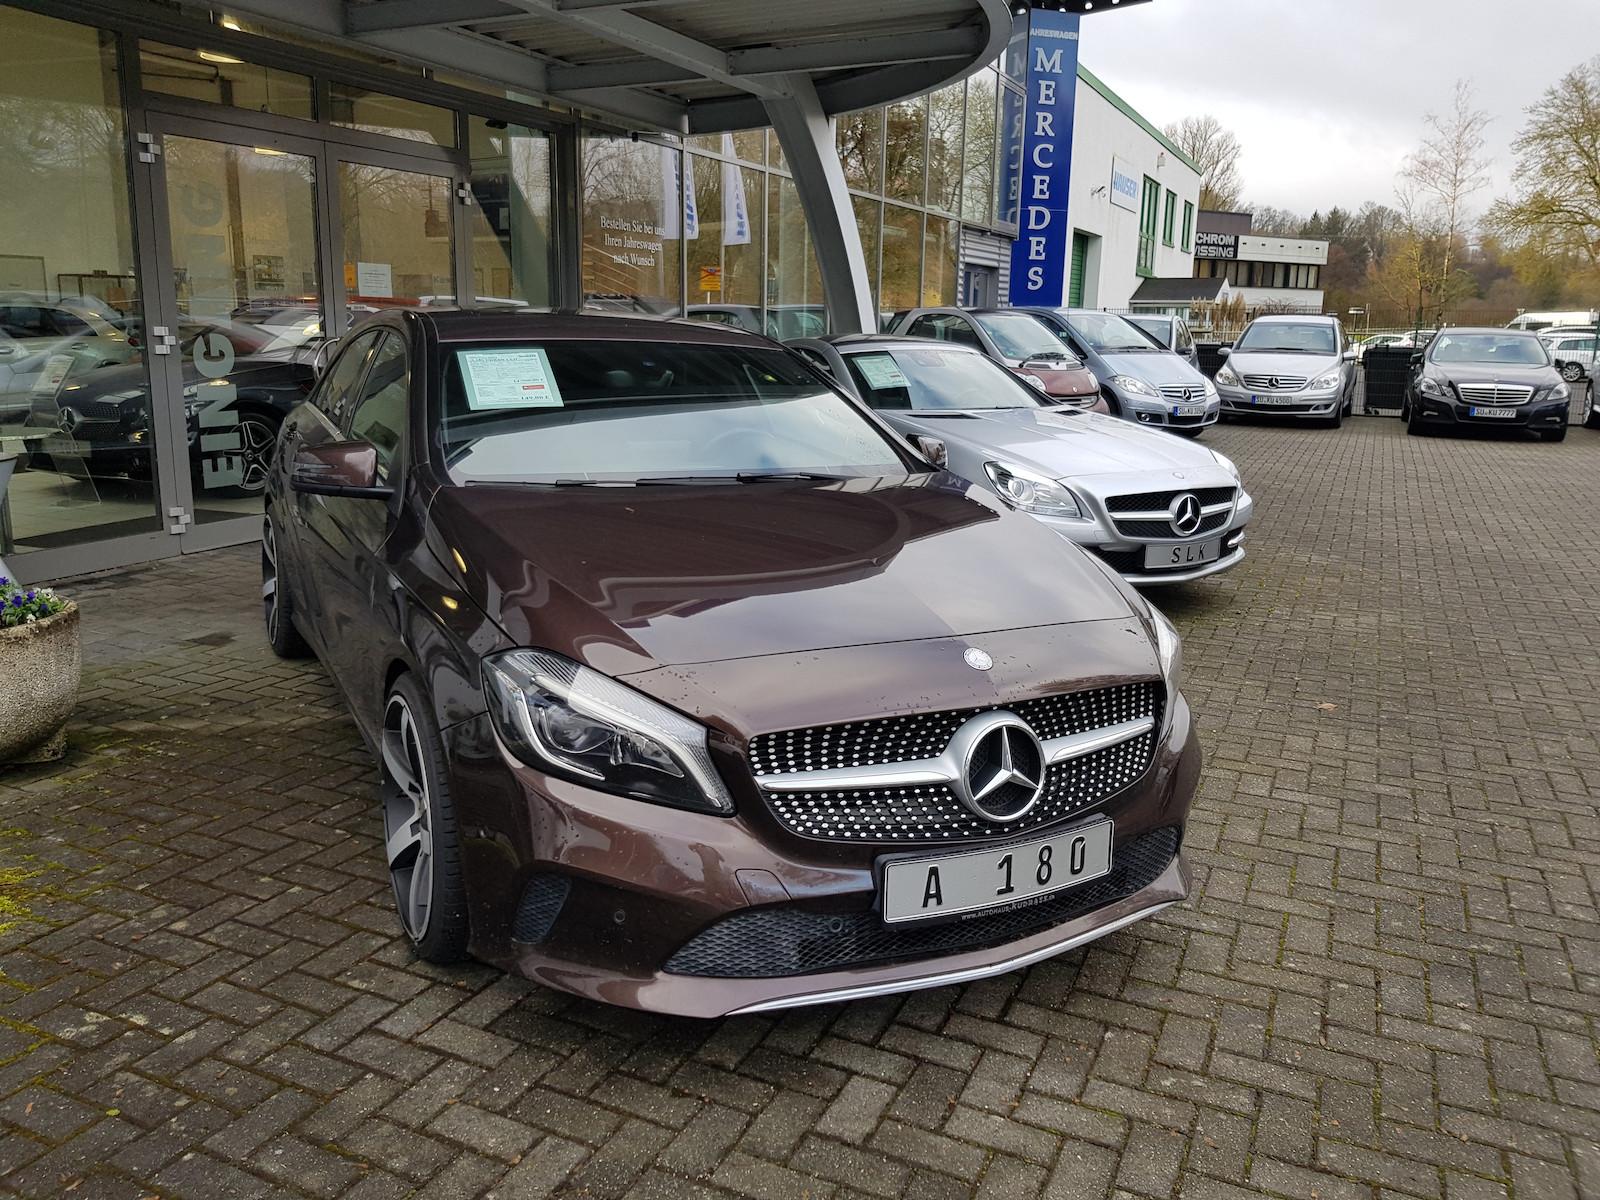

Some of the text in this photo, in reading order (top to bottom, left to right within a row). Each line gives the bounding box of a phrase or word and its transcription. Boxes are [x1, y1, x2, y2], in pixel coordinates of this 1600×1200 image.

[1027, 47, 1063, 291] MERCEDES
[600, 216, 665, 235] Bestellen Sie bei uns
[604, 234, 662, 253] Ihren Jahreswagen
[1196, 233, 1235, 245] CHROM
[614, 253, 655, 266] nach Wunsch
[1171, 544, 1206, 563] SLK
[922, 836, 1086, 908] A 180
